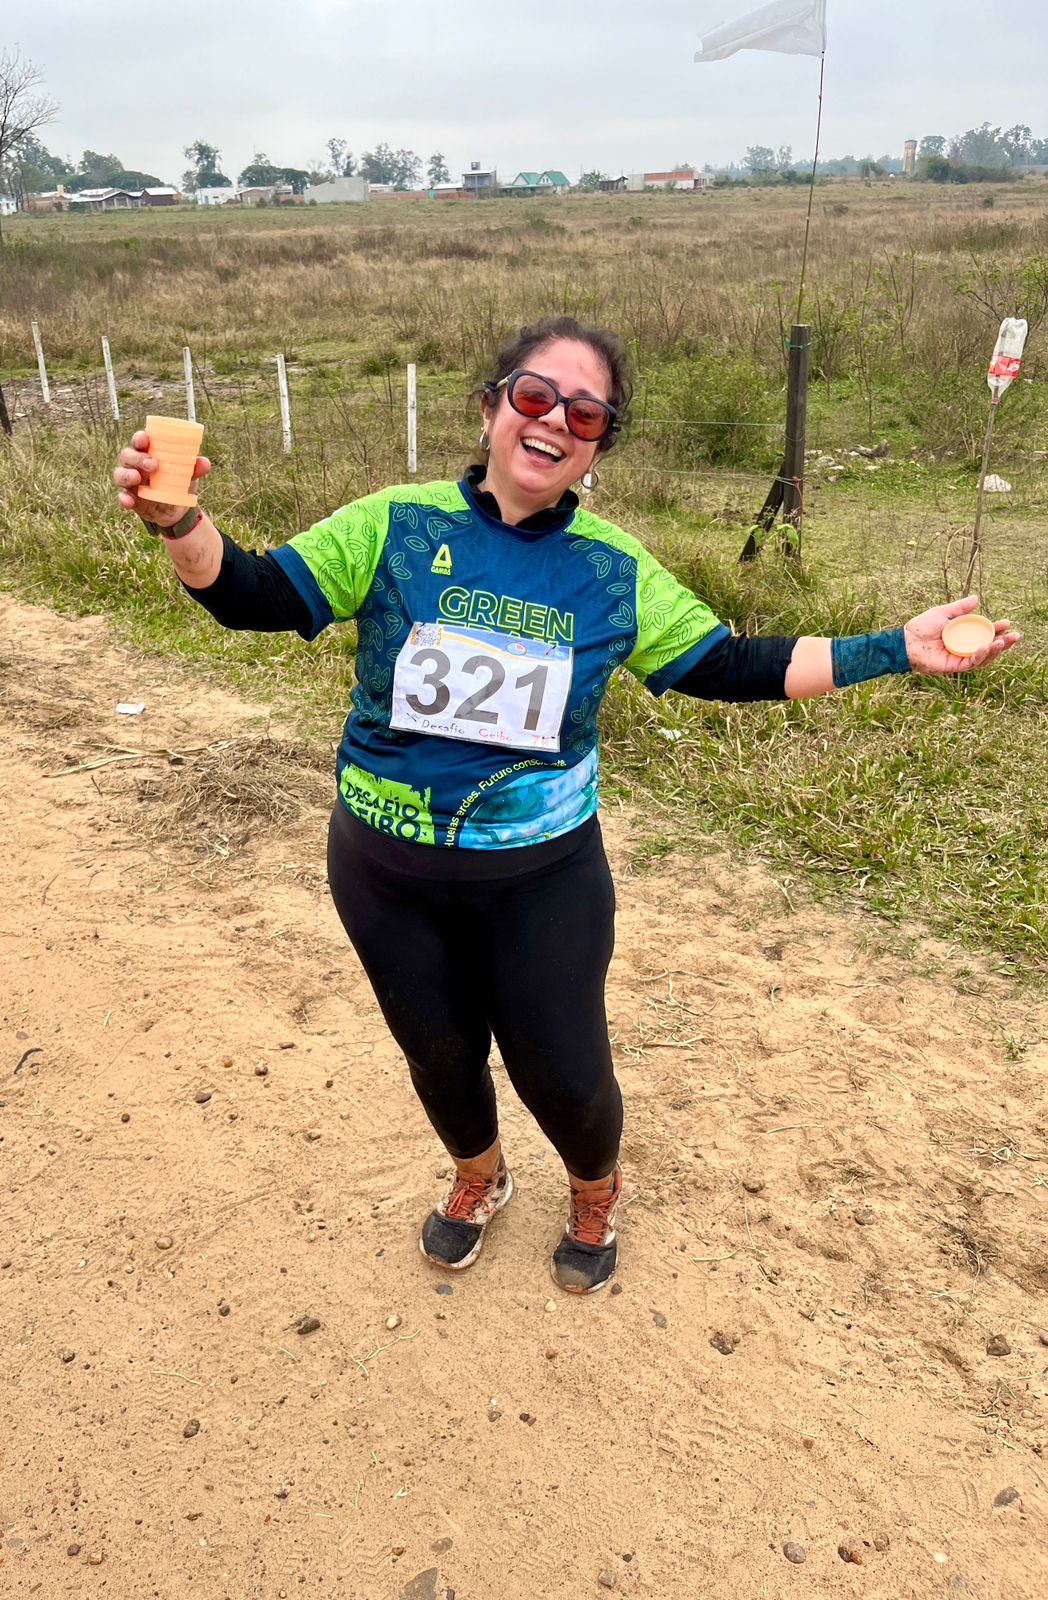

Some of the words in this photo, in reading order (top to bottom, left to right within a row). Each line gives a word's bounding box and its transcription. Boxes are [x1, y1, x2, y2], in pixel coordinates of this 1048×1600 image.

[438, 585, 574, 642] GREEN
[405, 647, 549, 731] 321
[421, 719, 465, 734] Desafio
[456, 790, 481, 817] erdes.
[478, 766, 514, 791] Futuro
